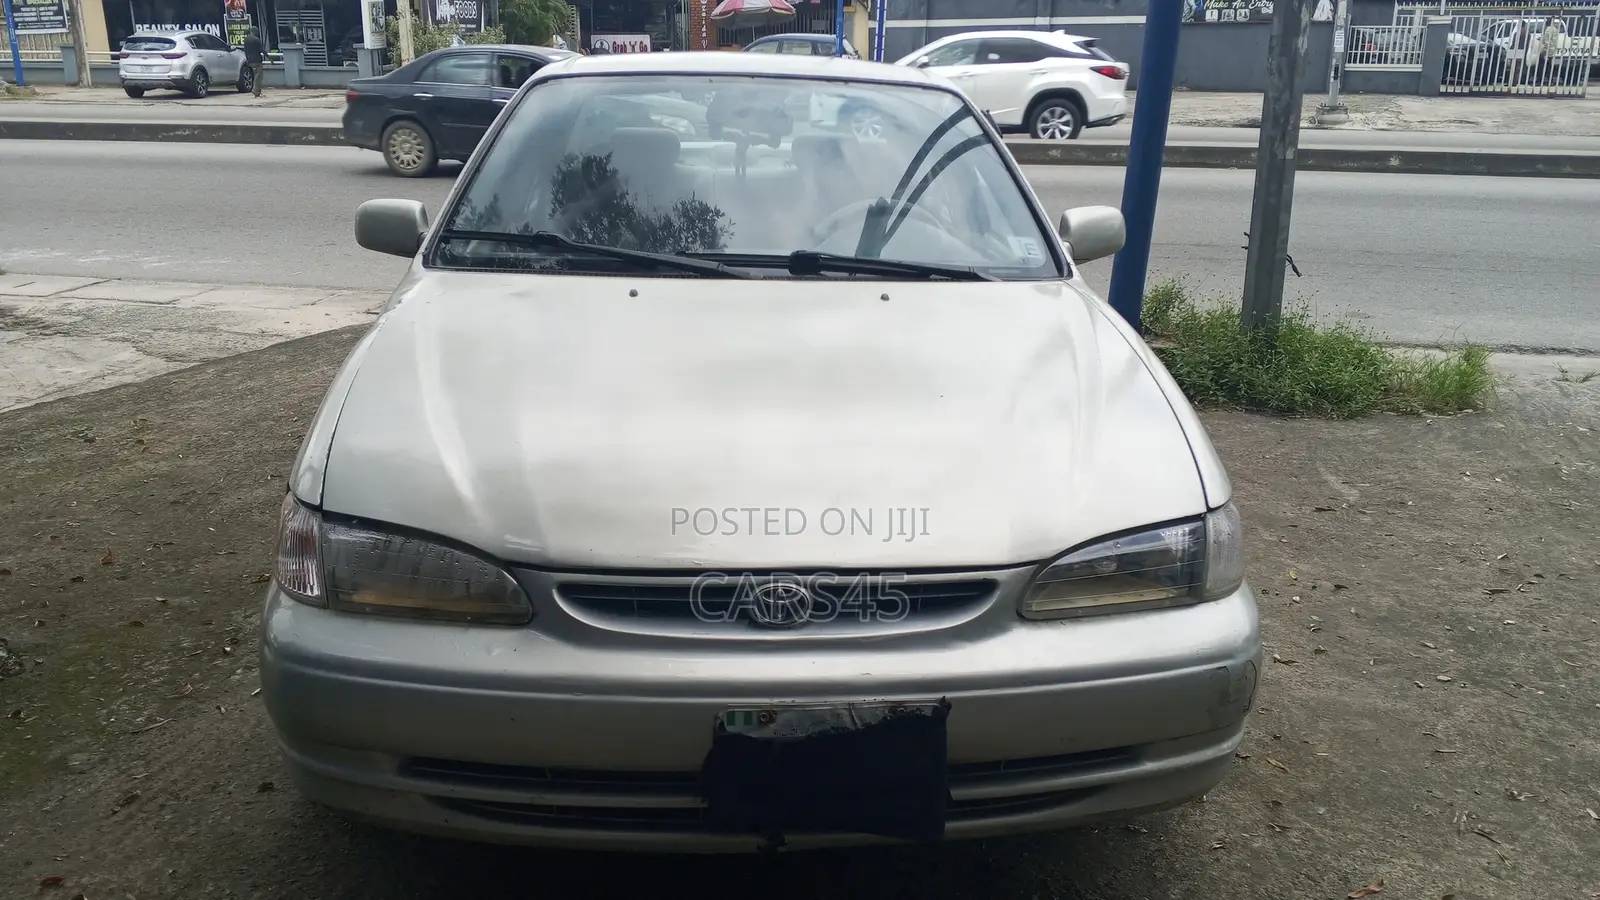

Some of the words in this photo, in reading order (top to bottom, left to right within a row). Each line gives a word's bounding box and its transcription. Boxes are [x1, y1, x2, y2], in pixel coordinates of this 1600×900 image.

[454, 0, 477, 19] FOODS
[1203, 0, 1229, 10] Make
[1232, 0, 1246, 9] An
[135, 23, 180, 32] BEAUTY
[184, 23, 220, 37] SALON
[612, 40, 628, 54] Grab
[639, 40, 648, 53] Go
